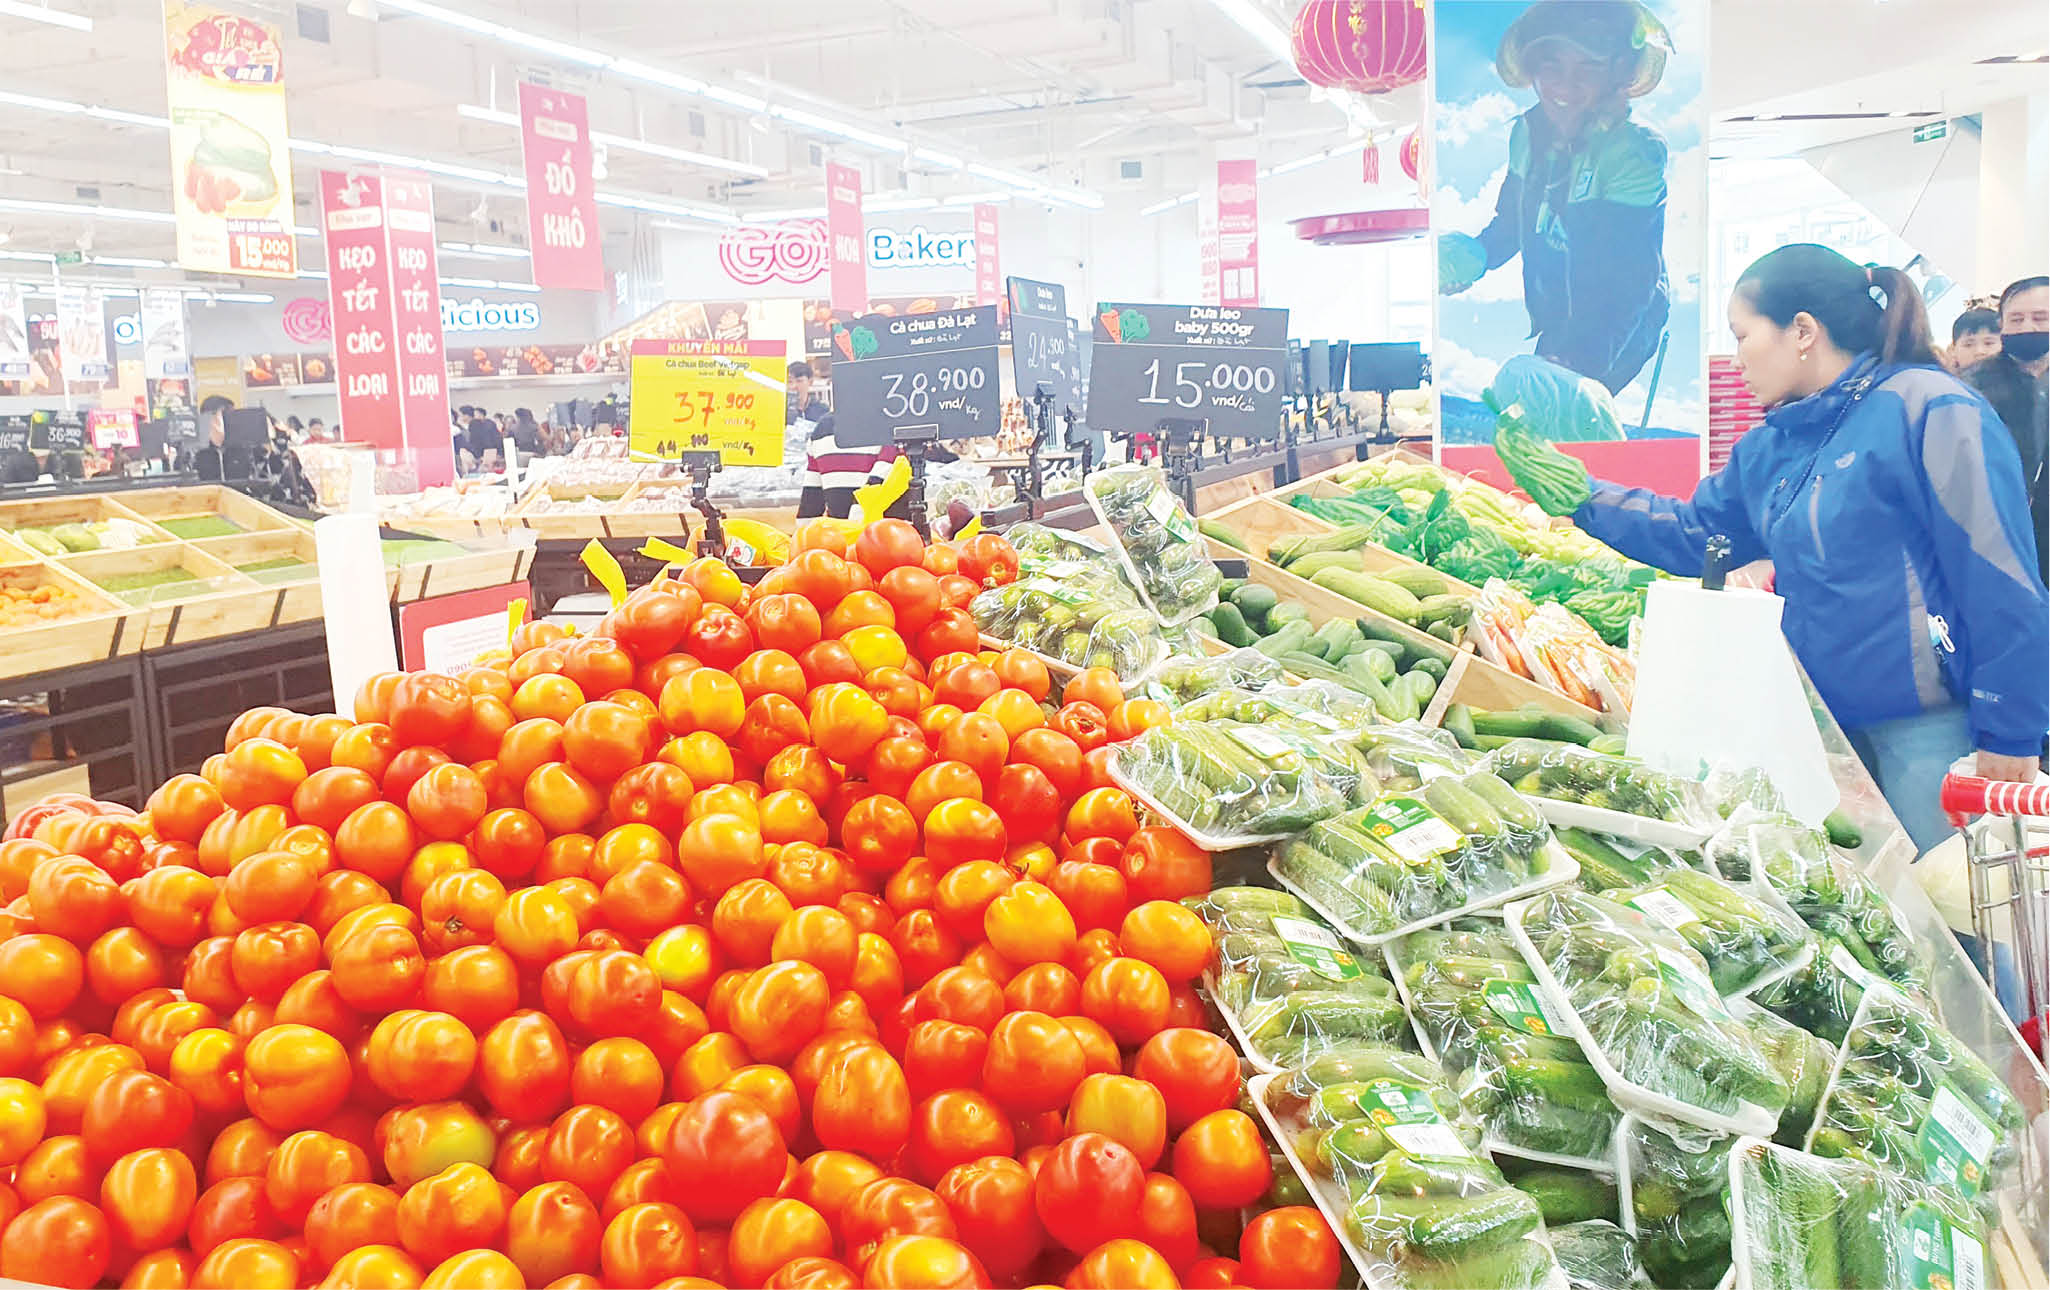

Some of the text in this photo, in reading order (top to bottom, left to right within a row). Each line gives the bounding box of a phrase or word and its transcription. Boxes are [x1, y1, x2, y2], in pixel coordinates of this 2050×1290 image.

[543, 205, 587, 249] KHÔ
[338, 245, 377, 275] KẸO
[342, 276, 379, 313] TẾT
[401, 278, 429, 313] TẾT
[889, 313, 977, 335] Cà chua Đà Lạt
[1174, 321, 1255, 337] baby 500gr
[1189, 306, 1242, 320] Dưa leo
[346, 323, 386, 355] CÁC
[406, 323, 437, 355] CÁC
[348, 373, 389, 401] LOẠI
[408, 373, 440, 401] LOẠI
[881, 366, 985, 418] 38.900
[1137, 358, 1276, 408] 15.000
[673, 391, 755, 429] 37.900
